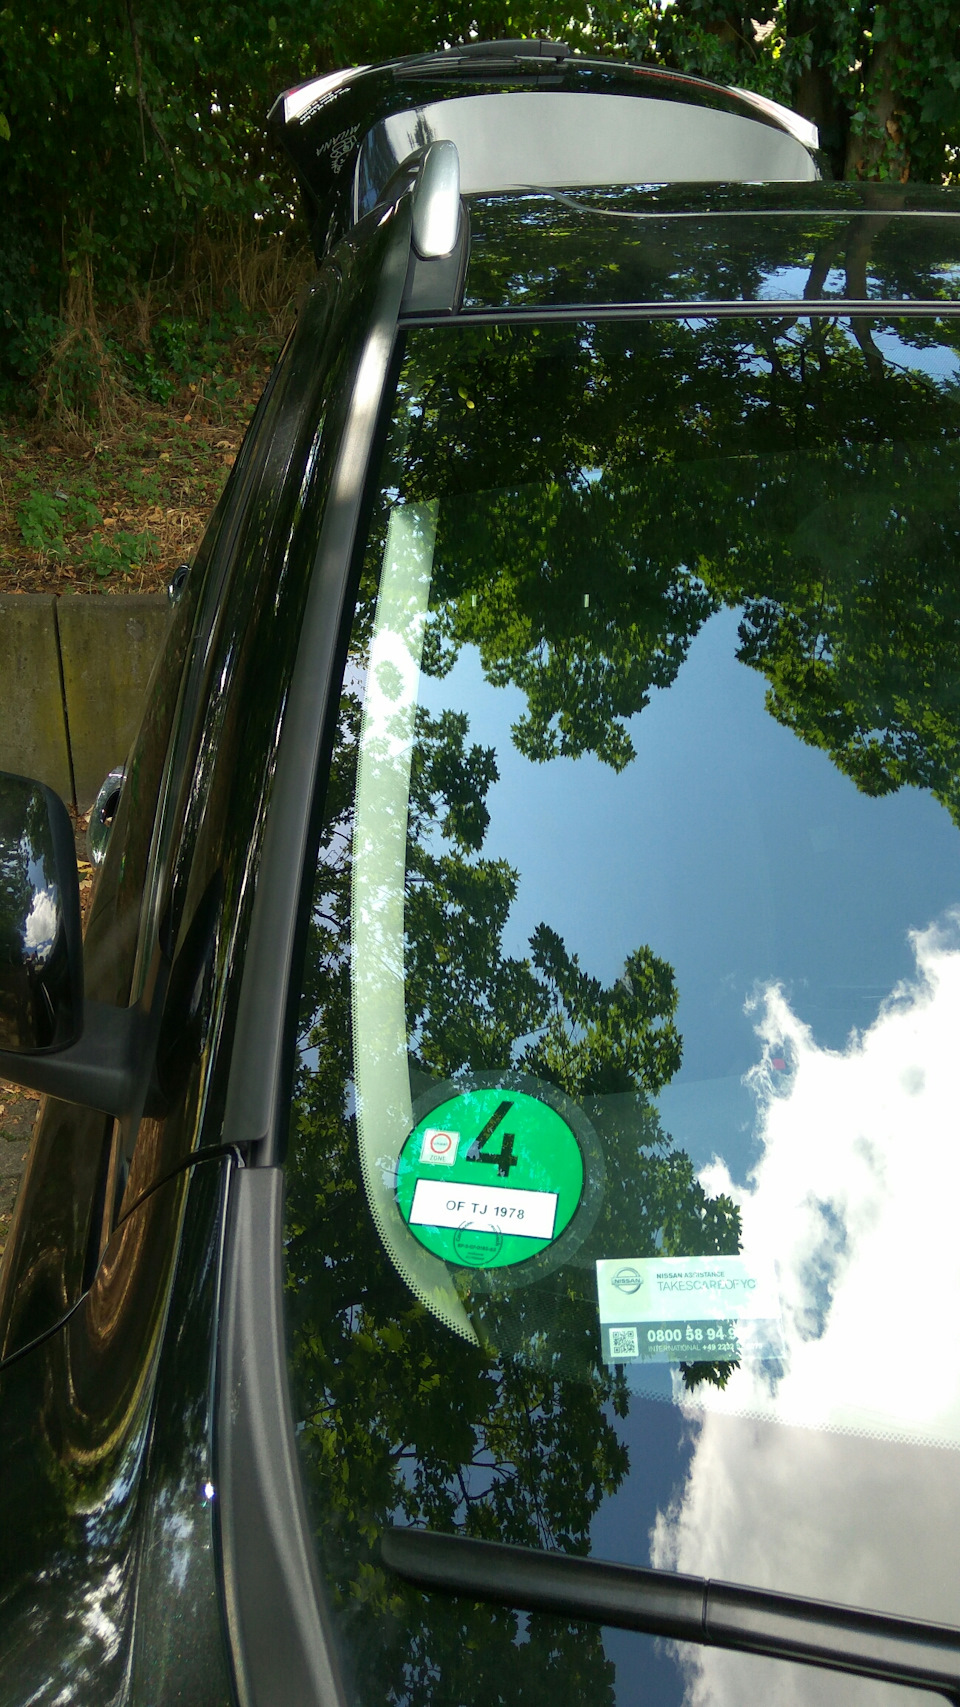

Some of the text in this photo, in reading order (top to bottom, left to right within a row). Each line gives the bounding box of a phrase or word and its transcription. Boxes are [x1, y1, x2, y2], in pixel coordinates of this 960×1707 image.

[316, 123, 361, 157] MILANA
[466, 1101, 518, 1177] 4
[429, 1155, 446, 1163] ZONE
[446, 1200, 525, 1220] OF TJ 1978
[647, 1329, 682, 1342] 0800
[686, 1328, 704, 1341] 58
[707, 1327, 725, 1340] 94
[648, 1344, 701, 1353] INTERNATIONAL
